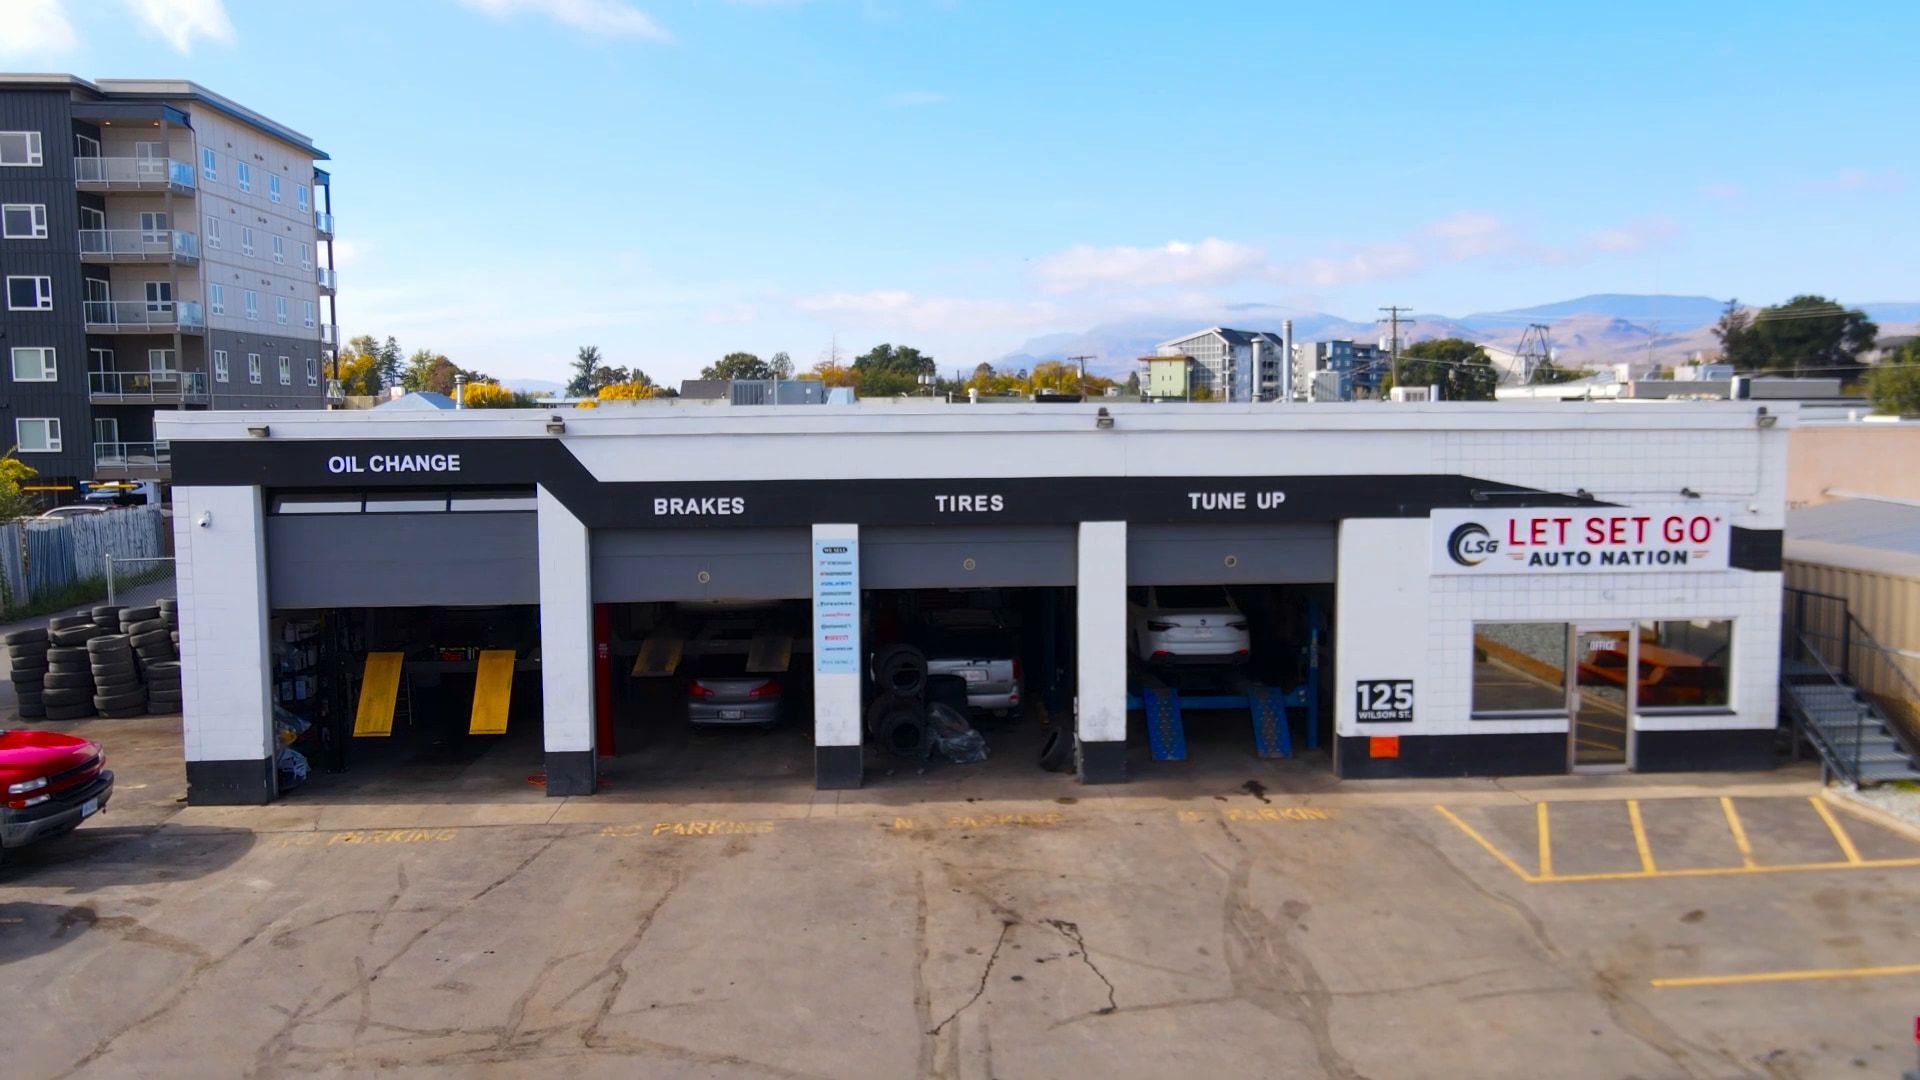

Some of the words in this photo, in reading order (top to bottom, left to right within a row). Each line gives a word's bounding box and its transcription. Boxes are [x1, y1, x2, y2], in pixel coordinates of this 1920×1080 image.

[328, 455, 366, 474] OIL
[369, 454, 461, 473] CHANGE
[653, 496, 745, 515] BRAKES
[934, 495, 1004, 513] TIRES
[1187, 492, 1246, 510] TUNE
[1256, 491, 1287, 509] UP
[1508, 517, 1571, 546] LET
[1585, 516, 1650, 545] SET
[1662, 515, 1711, 544] GO
[1463, 539, 1500, 554] LSG
[1528, 551, 1592, 567] AUTO
[1600, 550, 1688, 565] NATION
[1589, 640, 1616, 651] OFFICE
[1357, 683, 1413, 711] 125
[1358, 711, 1397, 719] WILSON
[1223, 807, 1330, 821] PARKIN
[652, 820, 775, 837] PARKING
